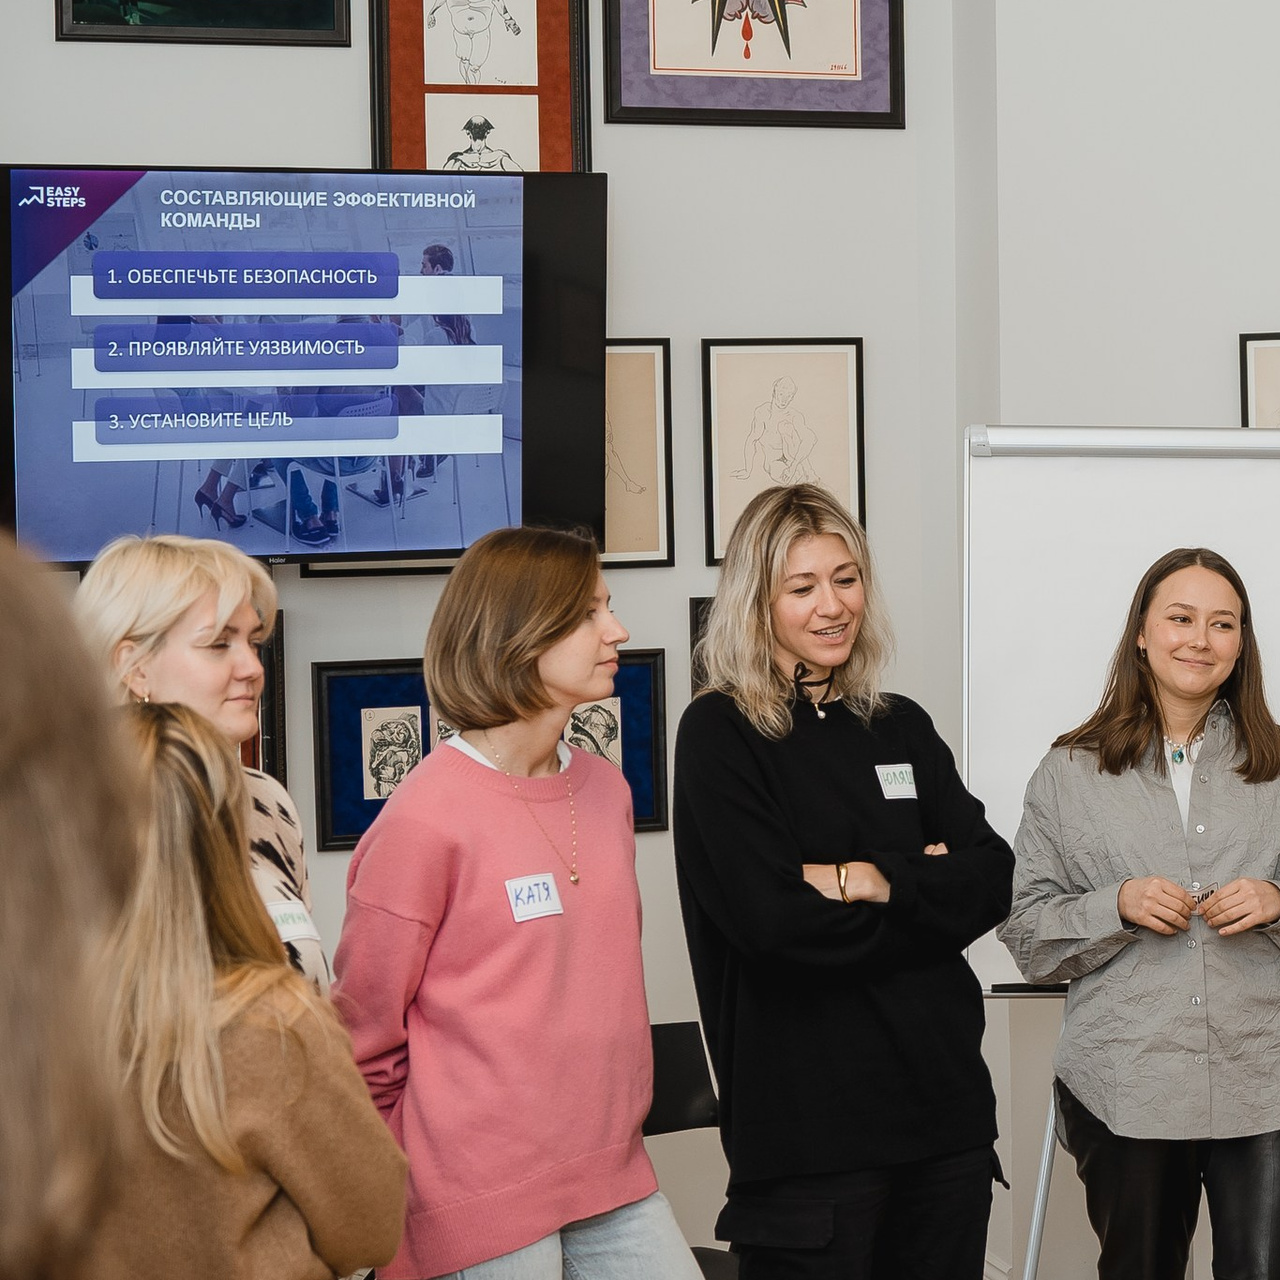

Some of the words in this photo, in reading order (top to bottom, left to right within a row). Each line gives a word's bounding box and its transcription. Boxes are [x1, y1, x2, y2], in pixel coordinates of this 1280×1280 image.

[46, 186, 80, 197] EASY
[160, 189, 328, 209] СОСТАВЛЯЮЩИЕ
[333, 190, 476, 208] ЭФФЕКТИВНОЙ
[46, 197, 86, 207] STEPS
[160, 212, 261, 231] КОМАНДЫ
[107, 269, 122, 284] 1.
[127, 269, 238, 284] ОБЕСПЕЧЬТЕ
[243, 269, 378, 284] БЕЗОПАСНОСТЬ
[108, 342, 123, 357] 2.
[128, 337, 245, 356] ПРОЯВЛЯЙТЕ
[249, 339, 365, 356] УЯЗВИМОСТЬ
[109, 414, 124, 429] 3.
[129, 412, 243, 429] УСТАНОВИТЕ
[248, 411, 293, 429] ЦЕЛЬ
[514, 881, 552, 907] КАТЯ
